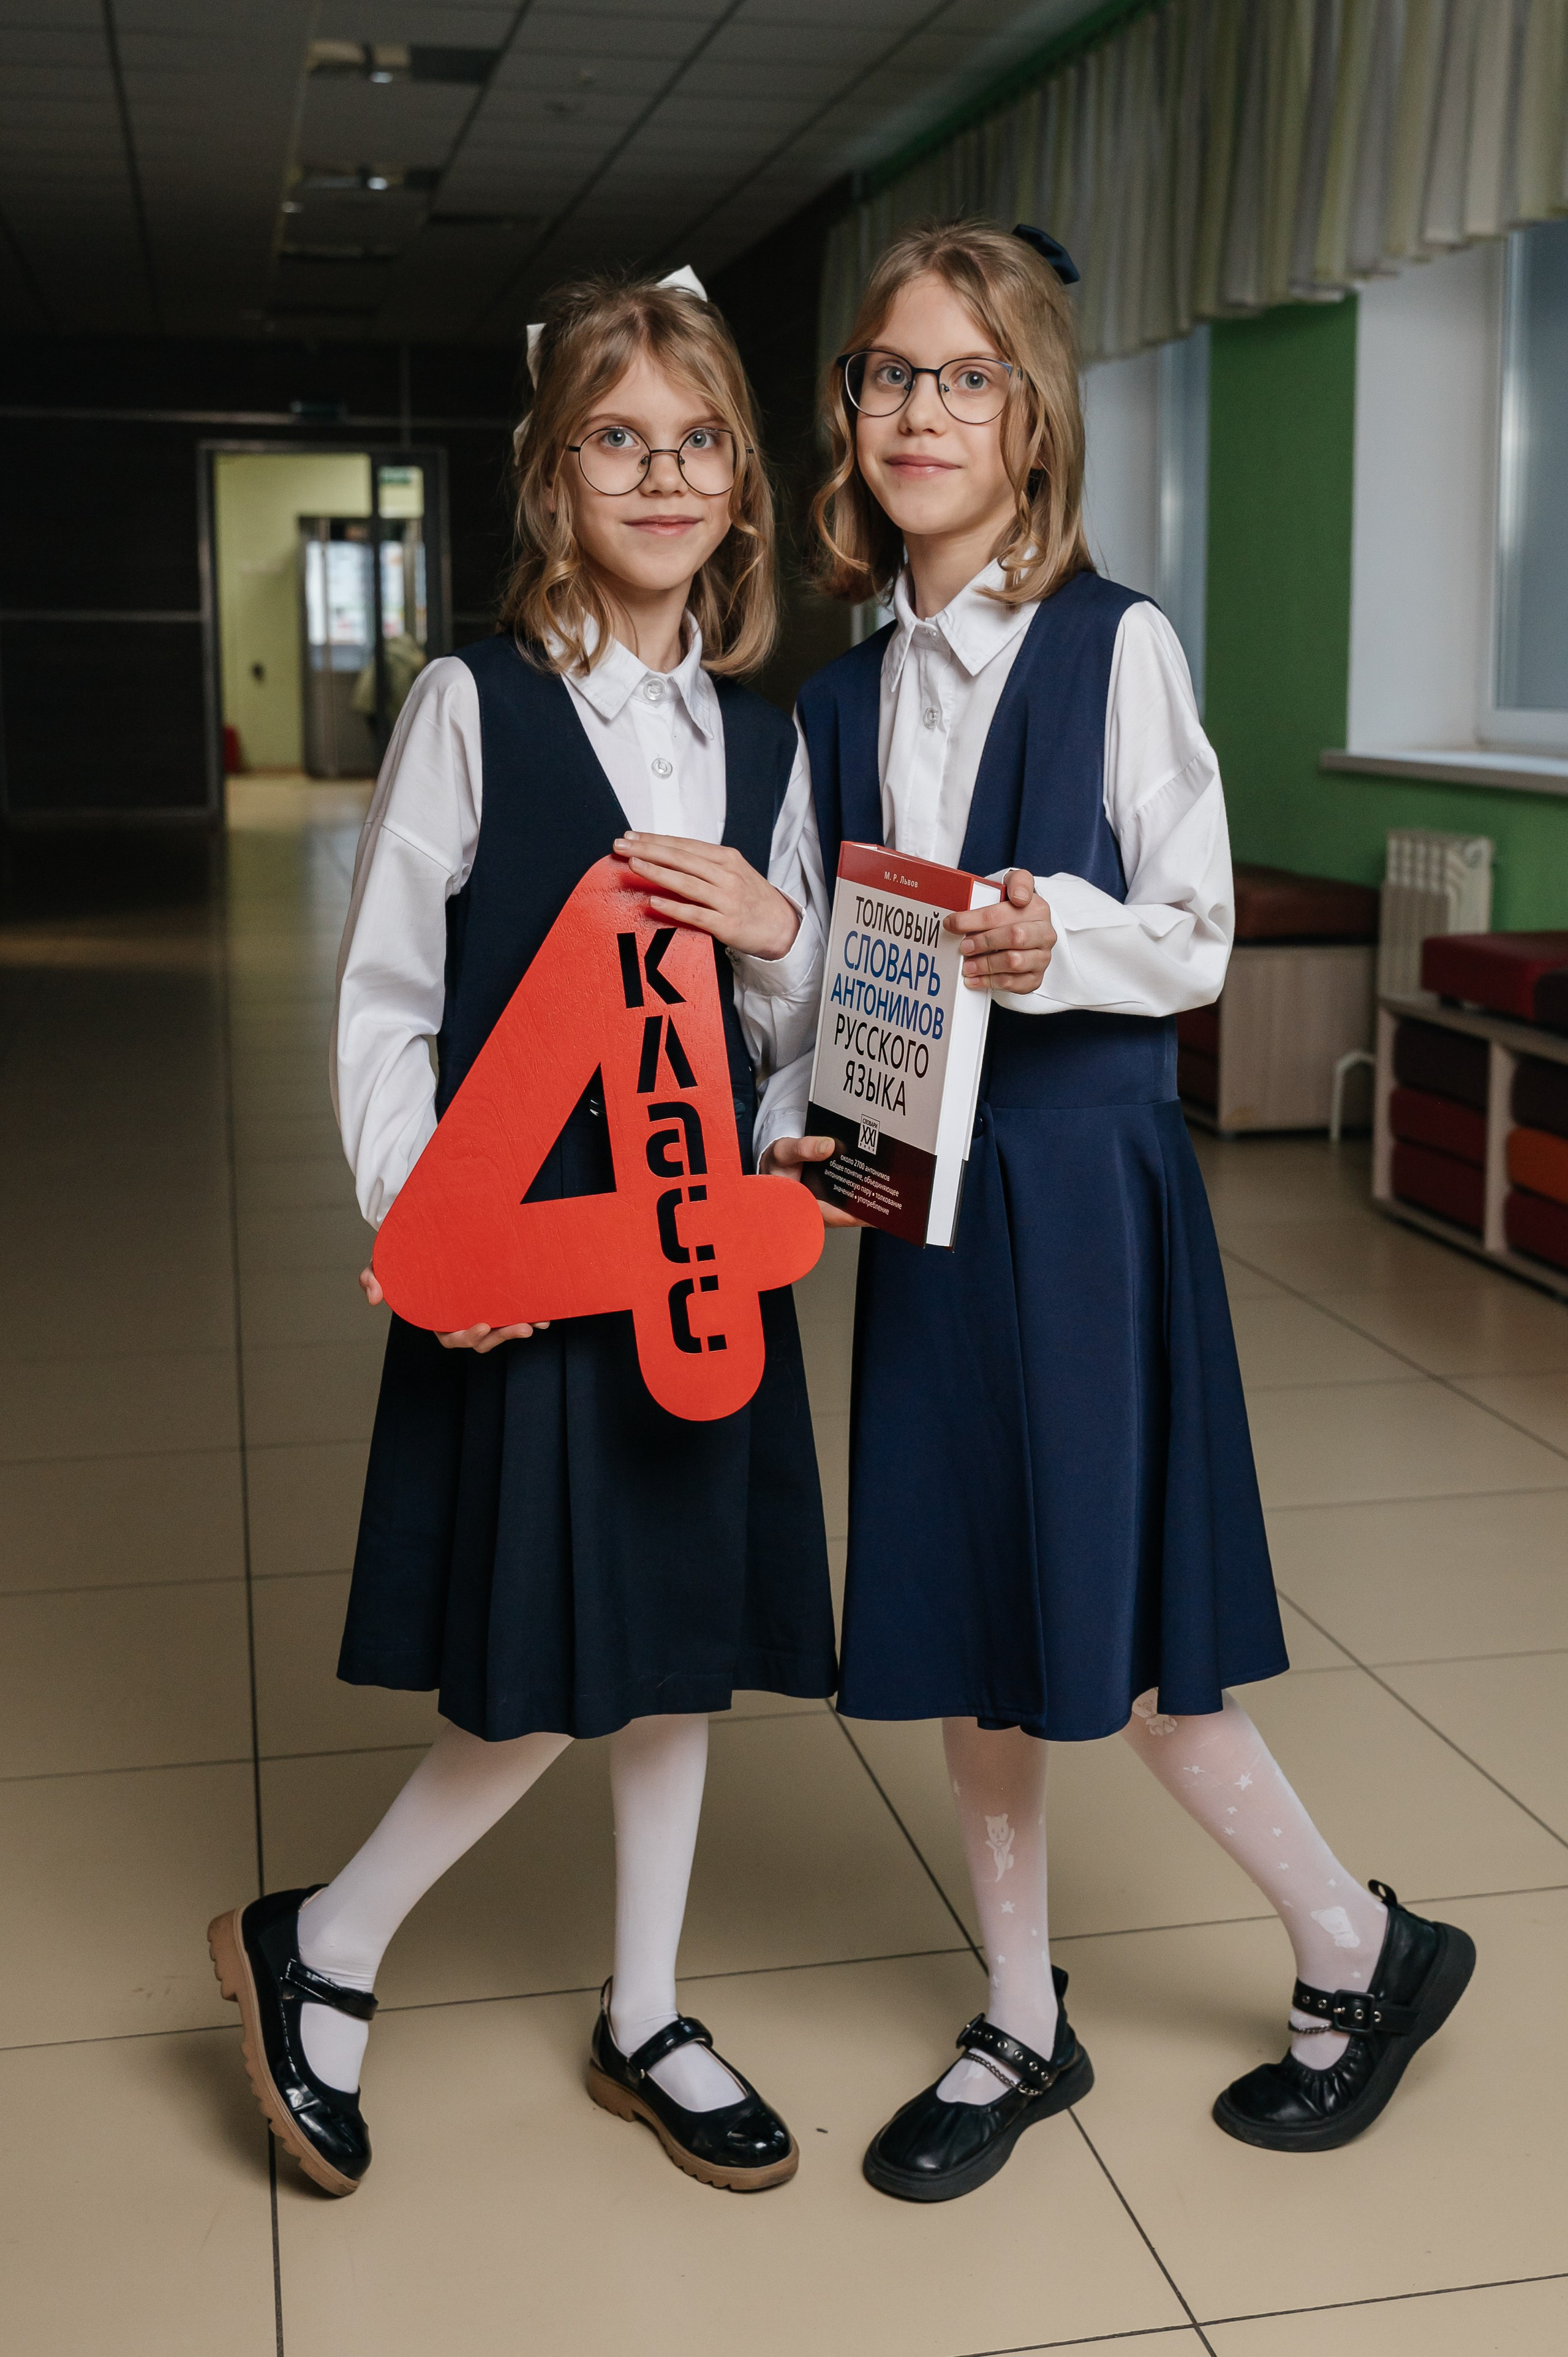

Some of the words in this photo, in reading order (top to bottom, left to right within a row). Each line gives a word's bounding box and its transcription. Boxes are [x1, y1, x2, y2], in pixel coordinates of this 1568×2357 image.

[884, 871, 891, 880] М.
[893, 874, 899, 882] Р.
[900, 876, 918, 888] Львов
[856, 896, 940, 948] ТОЛКОВЫЙ
[843, 931, 941, 996] СЛОВАРЬ
[830, 973, 944, 1040] АНТОНИМОВ
[834, 1012, 929, 1079] РУССКОГО
[843, 1060, 906, 1116] ЯЗЫКА
[372, 853, 825, 1421] 4
[862, 1118, 878, 1129] СЛОВАРИ
[840, 1154, 854, 1165] около
[854, 1159, 865, 1170] 2700
[865, 1167, 890, 1181] антонимов
[859, 1143, 875, 1152] века
[824, 1169, 860, 1190] антонимическую
[861, 1186, 872, 1197] пару
[875, 1192, 902, 1209] толкование
[830, 1160, 844, 1171] общее
[844, 1167, 864, 1181] понятие,
[864, 1176, 899, 1197] объединяющее
[833, 1184, 854, 1198] значений
[858, 1195, 889, 1215] употребление
